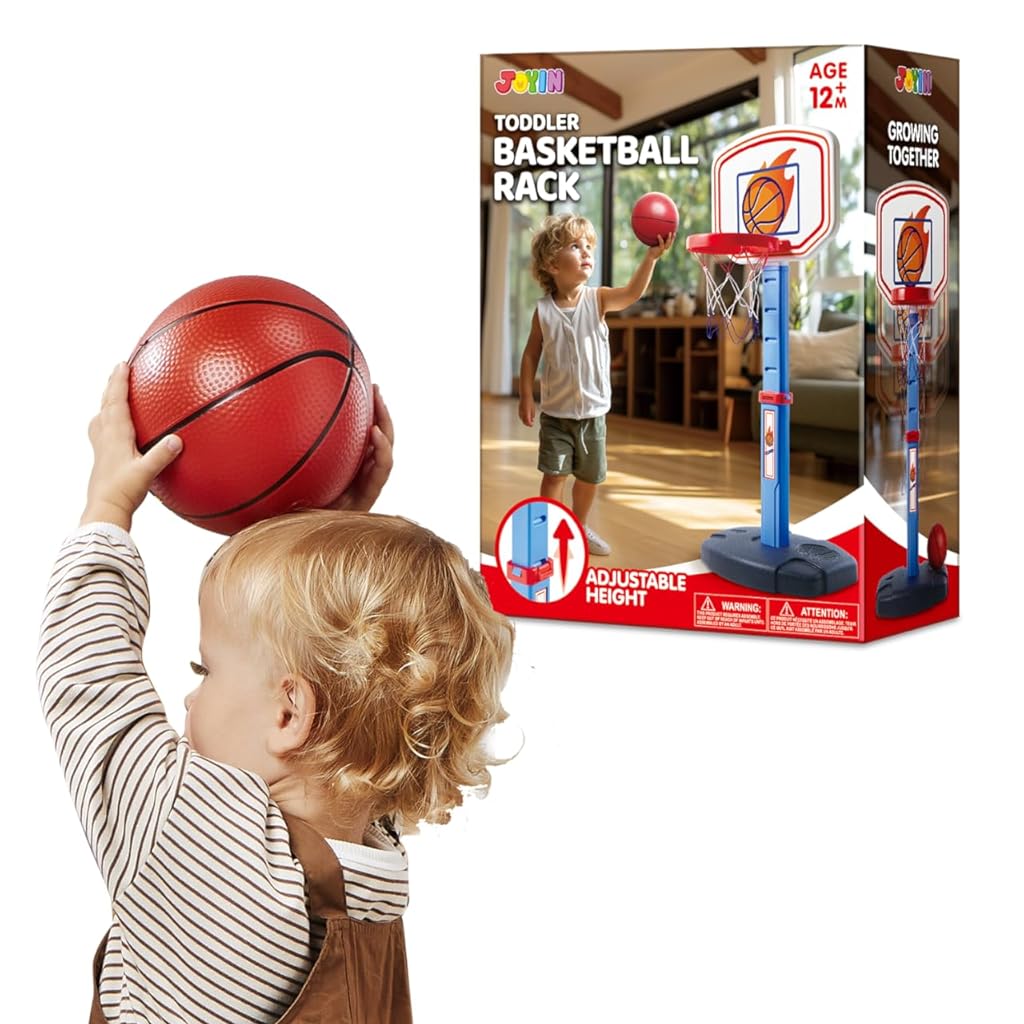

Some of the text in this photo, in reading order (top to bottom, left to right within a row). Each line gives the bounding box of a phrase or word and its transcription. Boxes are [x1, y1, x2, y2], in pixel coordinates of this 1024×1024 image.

[494, 68, 565, 95] JOYIN
[809, 62, 847, 79] AGE
[895, 65, 932, 96] JOYIN
[494, 113, 580, 131] TODDLER
[887, 120, 939, 145] GROWING
[493, 135, 699, 166] BASKETBALL
[887, 144, 939, 168] TOGETHER
[493, 171, 581, 202] RACK
[585, 568, 687, 592] ADJUSTABLE
[585, 586, 648, 607] HEIGHT
[721, 600, 762, 613] WARNING:
[800, 606, 849, 619] ATTENTION:
